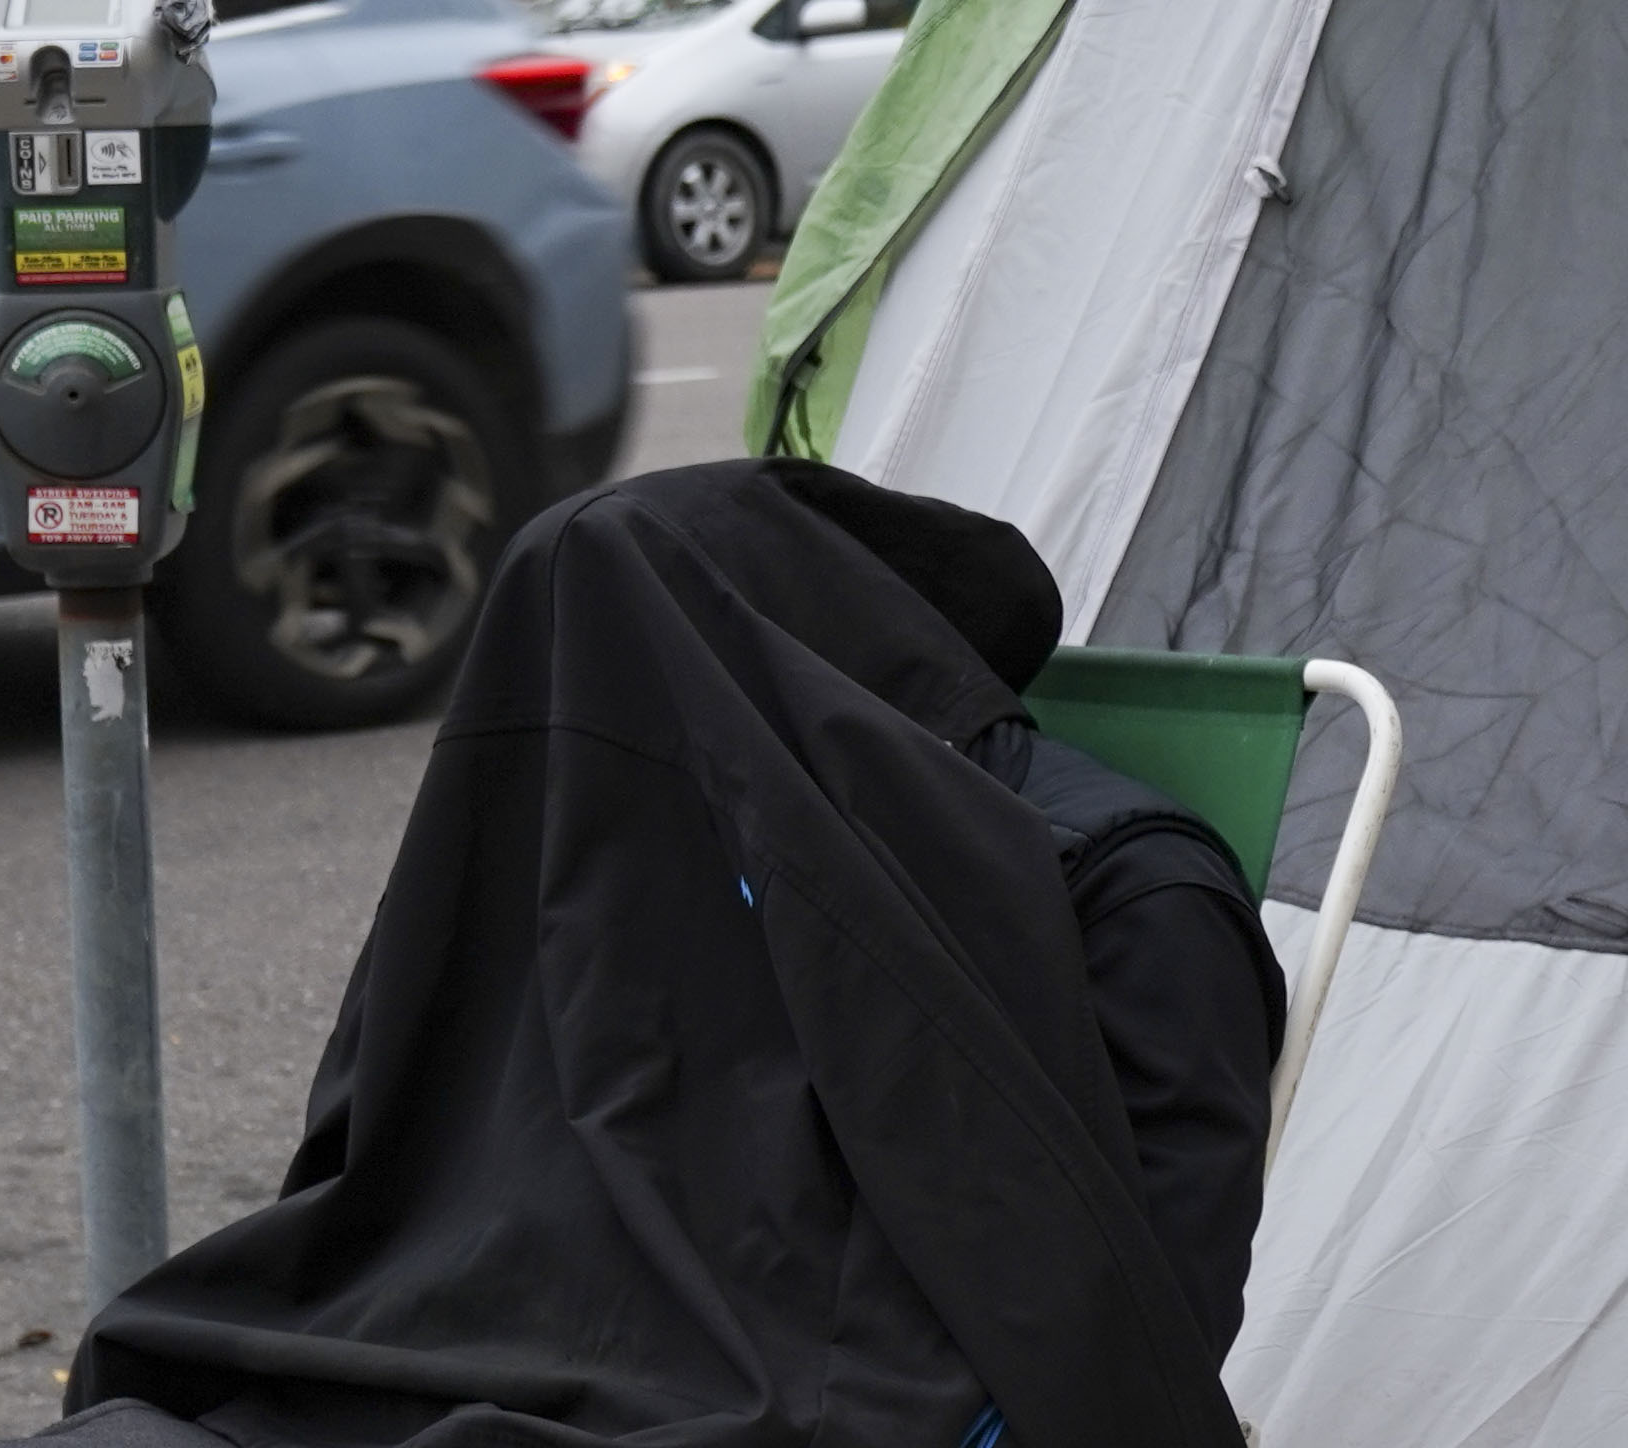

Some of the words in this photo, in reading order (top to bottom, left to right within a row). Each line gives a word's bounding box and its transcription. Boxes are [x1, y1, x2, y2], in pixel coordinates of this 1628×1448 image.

[19, 138, 32, 190] COINS
[19, 211, 52, 224] PAID
[56, 210, 120, 223] PARKING
[44, 222, 62, 232] ALL
[66, 222, 95, 232] TIMES
[36, 489, 74, 499] STREET
[77, 488, 131, 499] SWEEPING
[69, 512, 117, 521] TUESDAY
[70, 523, 128, 533] THURSDAY
[41, 534, 63, 543] TOW
[66, 534, 94, 543] AWAY
[97, 534, 125, 543] ZONE
